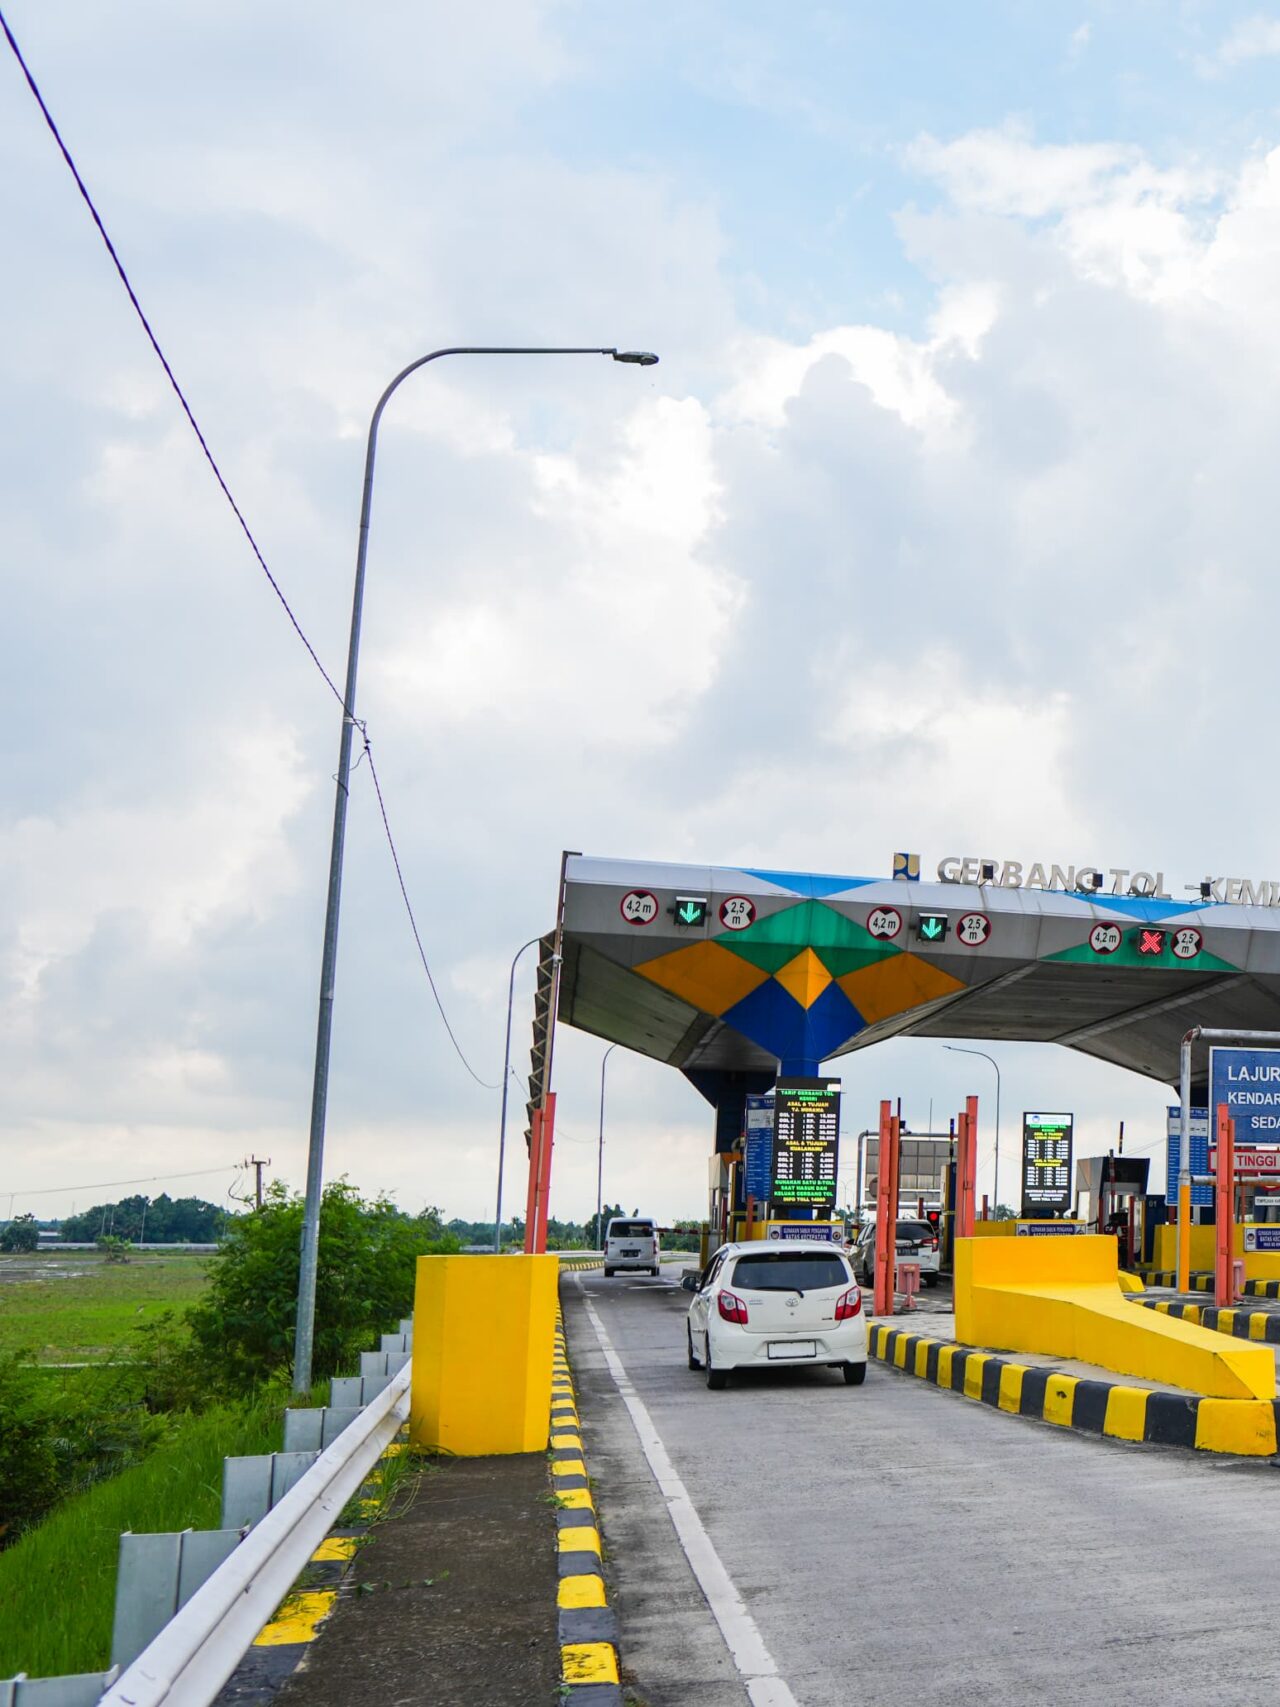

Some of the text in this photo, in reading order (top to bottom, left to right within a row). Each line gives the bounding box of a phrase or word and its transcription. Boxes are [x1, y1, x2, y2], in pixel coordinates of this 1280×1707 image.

[937, 856, 1099, 893] GERBANG
[1109, 868, 1171, 898] TOL
[626, 900, 652, 913] 4,2 m
[730, 902, 745, 915] 2,5
[732, 916, 741, 925] m
[873, 918, 896, 930] 4,2 m
[968, 918, 981, 931] 2,5
[969, 931, 977, 940] m
[1109, 935, 1117, 943] m
[1181, 933, 1194, 945] 2,5
[1182, 945, 1189, 954] m
[1228, 1065, 1280, 1082] LAJUR
[1237, 1155, 1277, 1167] TINGGI
